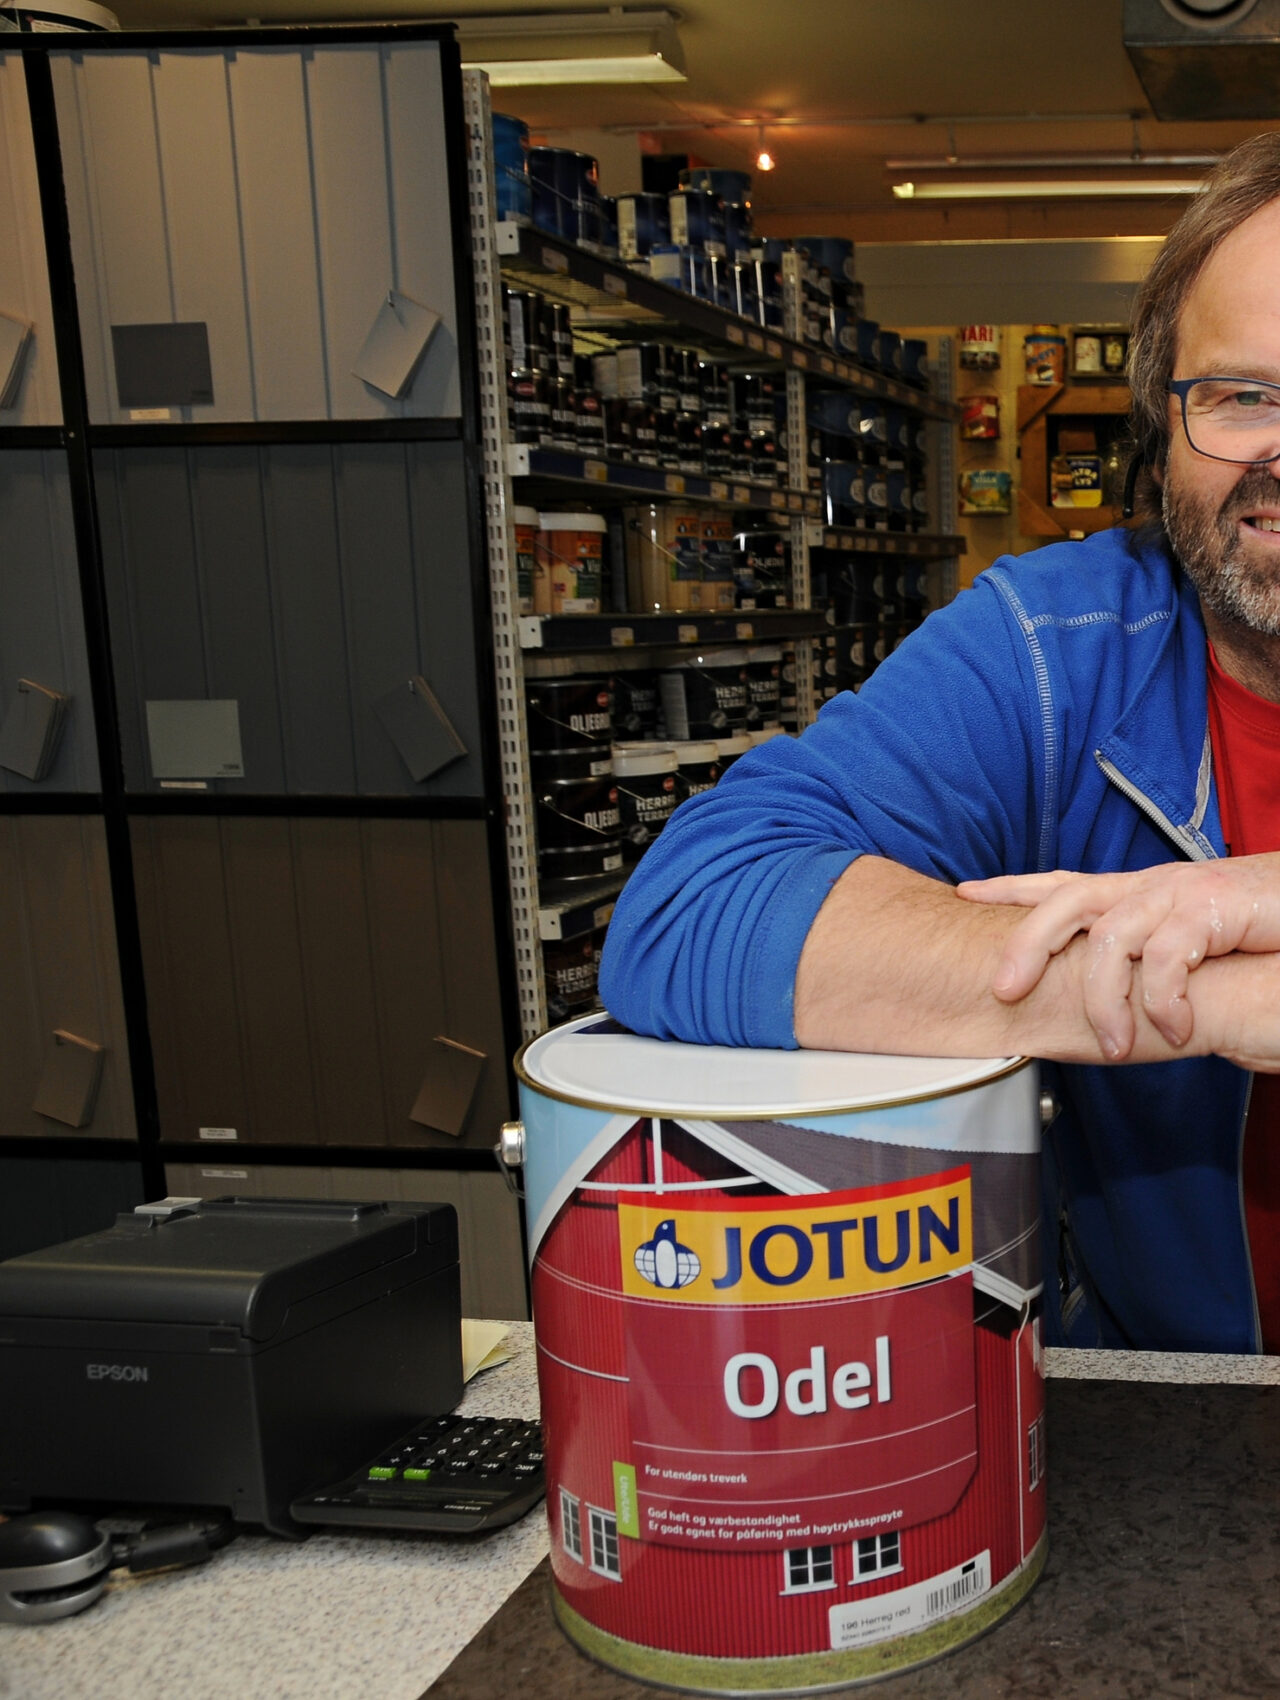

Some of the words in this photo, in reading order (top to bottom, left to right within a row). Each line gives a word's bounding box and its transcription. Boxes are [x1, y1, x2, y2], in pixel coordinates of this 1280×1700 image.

[712, 1197, 961, 1290] JOTUN
[87, 1364, 148, 1382] EPSON
[723, 1335, 893, 1421] Odel
[645, 1465, 660, 1476] For
[662, 1468, 708, 1483] utendørs
[710, 1472, 748, 1484] treverk
[648, 1507, 668, 1519] God
[669, 1510, 690, 1523] heft
[693, 1515, 706, 1527] og
[708, 1513, 801, 1527] værbestandighet
[649, 1520, 659, 1531] Er
[661, 1521, 684, 1537] godt
[686, 1527, 716, 1540] egnet
[718, 1527, 735, 1539] for
[736, 1525, 784, 1541] påføring
[786, 1524, 810, 1538] med
[812, 1508, 904, 1536] høytrykkssprøyte
